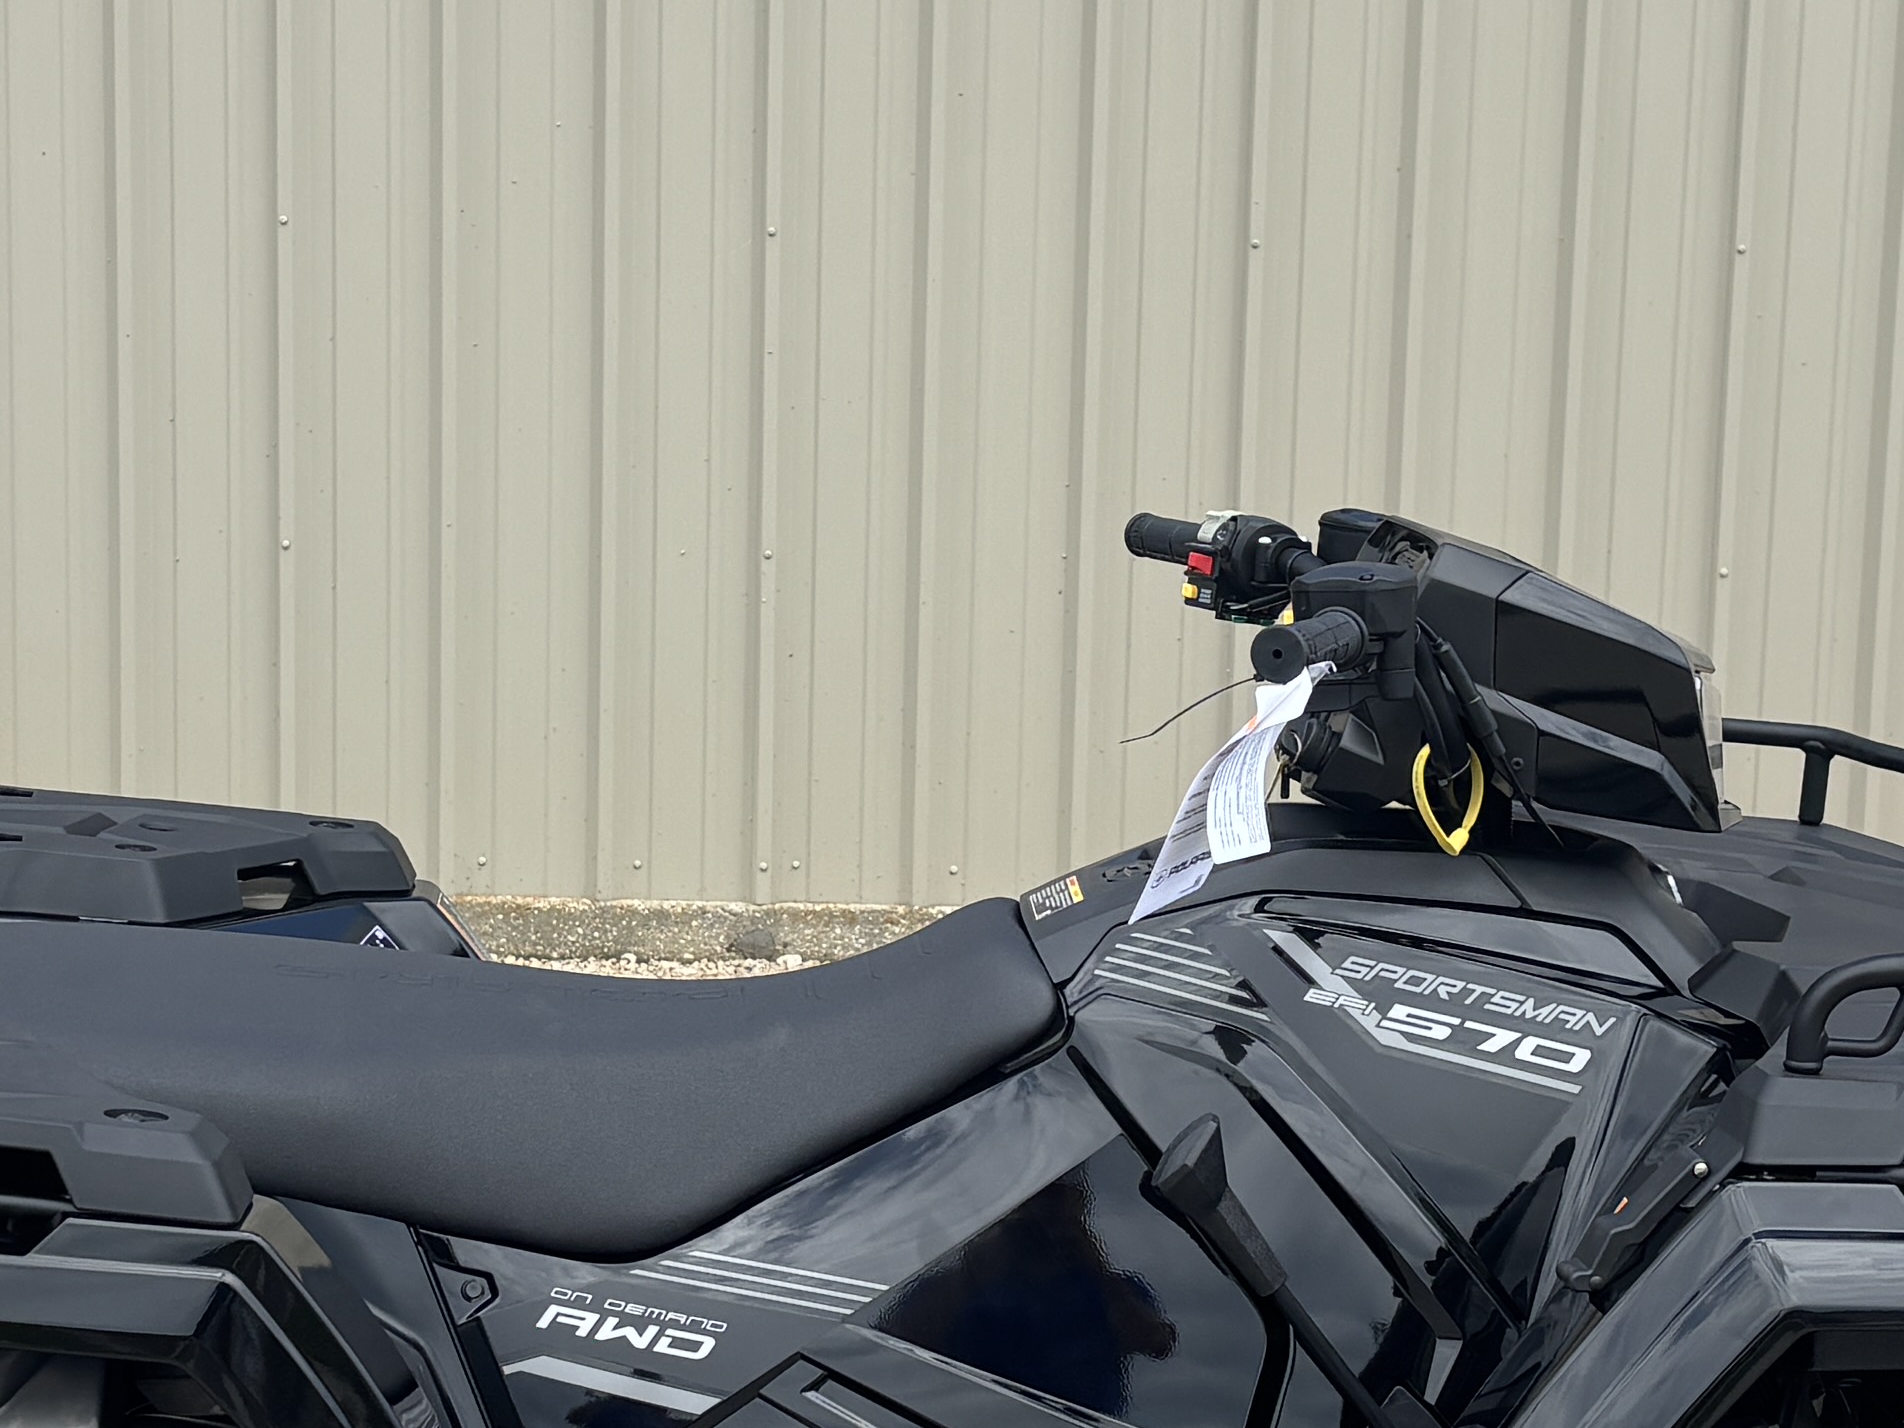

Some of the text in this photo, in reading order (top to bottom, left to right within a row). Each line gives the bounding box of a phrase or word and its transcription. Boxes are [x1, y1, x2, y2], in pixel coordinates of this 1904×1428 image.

[1303, 987, 1592, 1074] EFI 570
[1333, 955, 1618, 1037] SPORTSMAN
[535, 1304, 717, 1361] AWD
[550, 1287, 728, 1333] ON DEMAND
